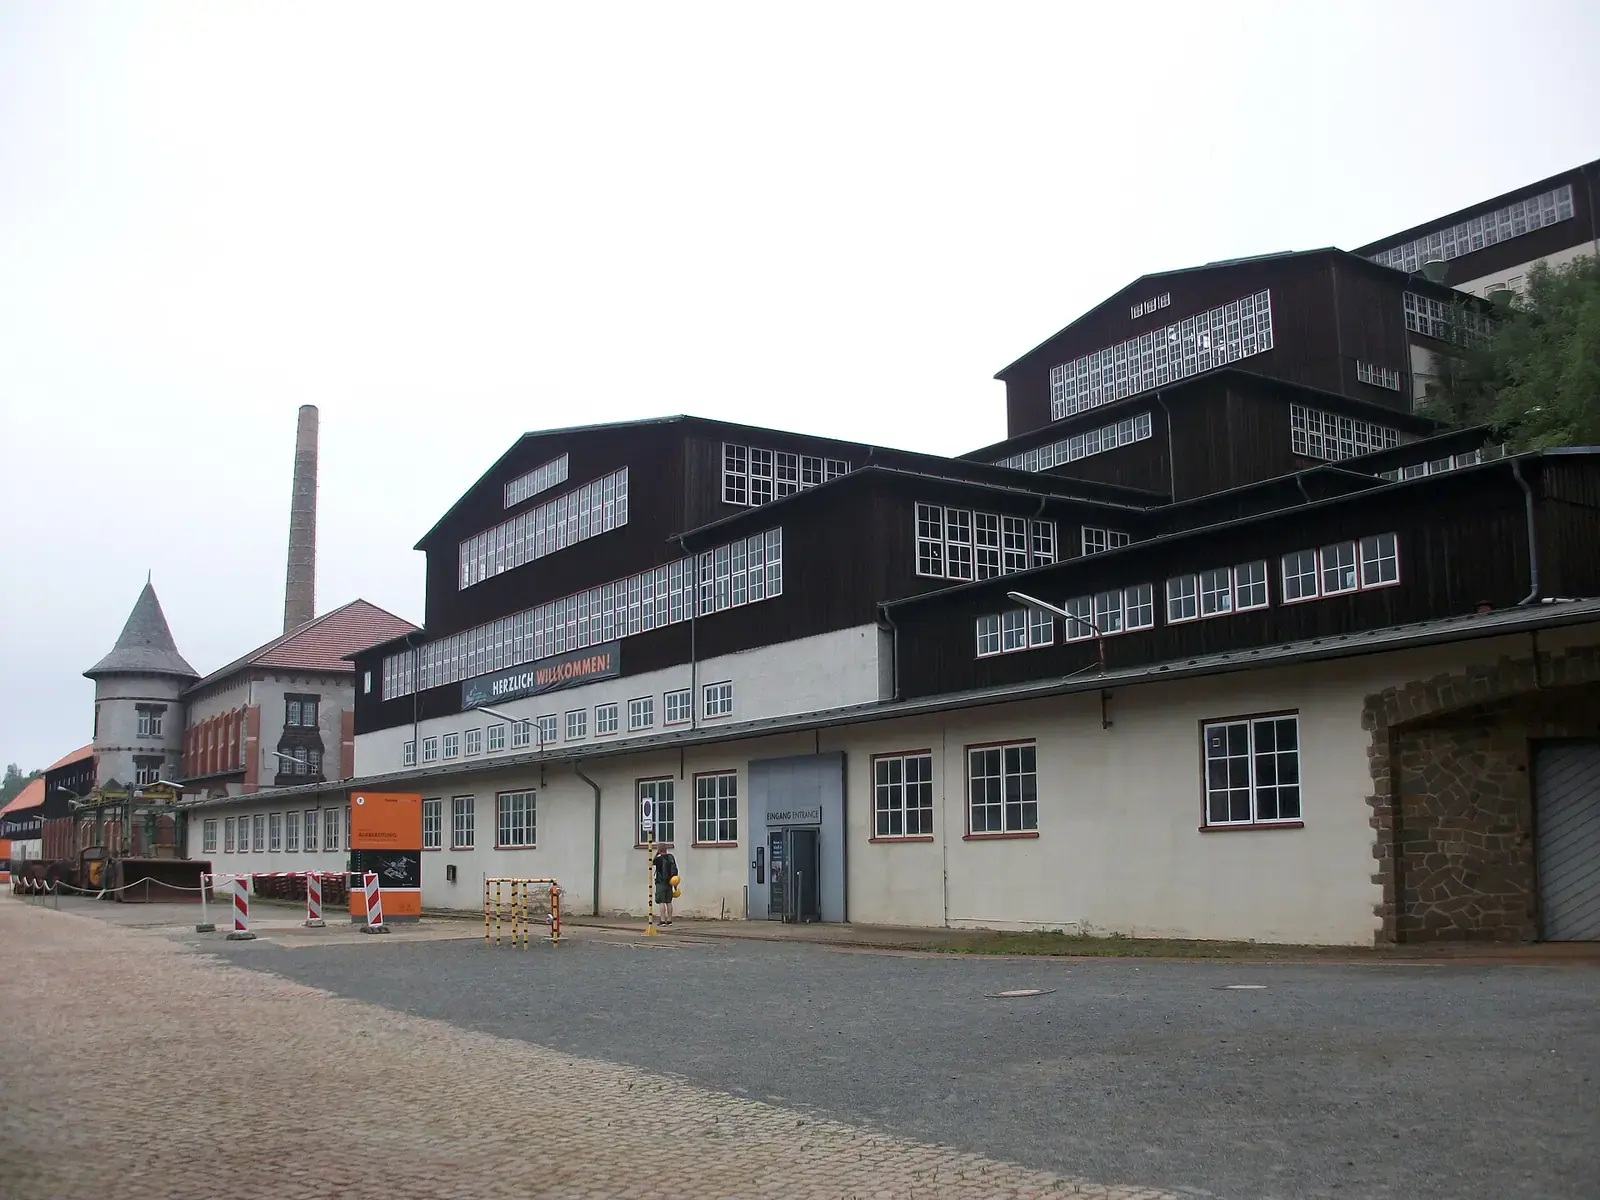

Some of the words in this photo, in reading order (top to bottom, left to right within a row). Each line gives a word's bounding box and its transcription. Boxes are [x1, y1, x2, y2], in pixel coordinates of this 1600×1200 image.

[492, 672, 534, 696] HERZLICH
[536, 653, 610, 685] WILLKOMMEN!
[767, 812, 791, 820] EINGANG
[792, 810, 819, 819] ENTRANCE
